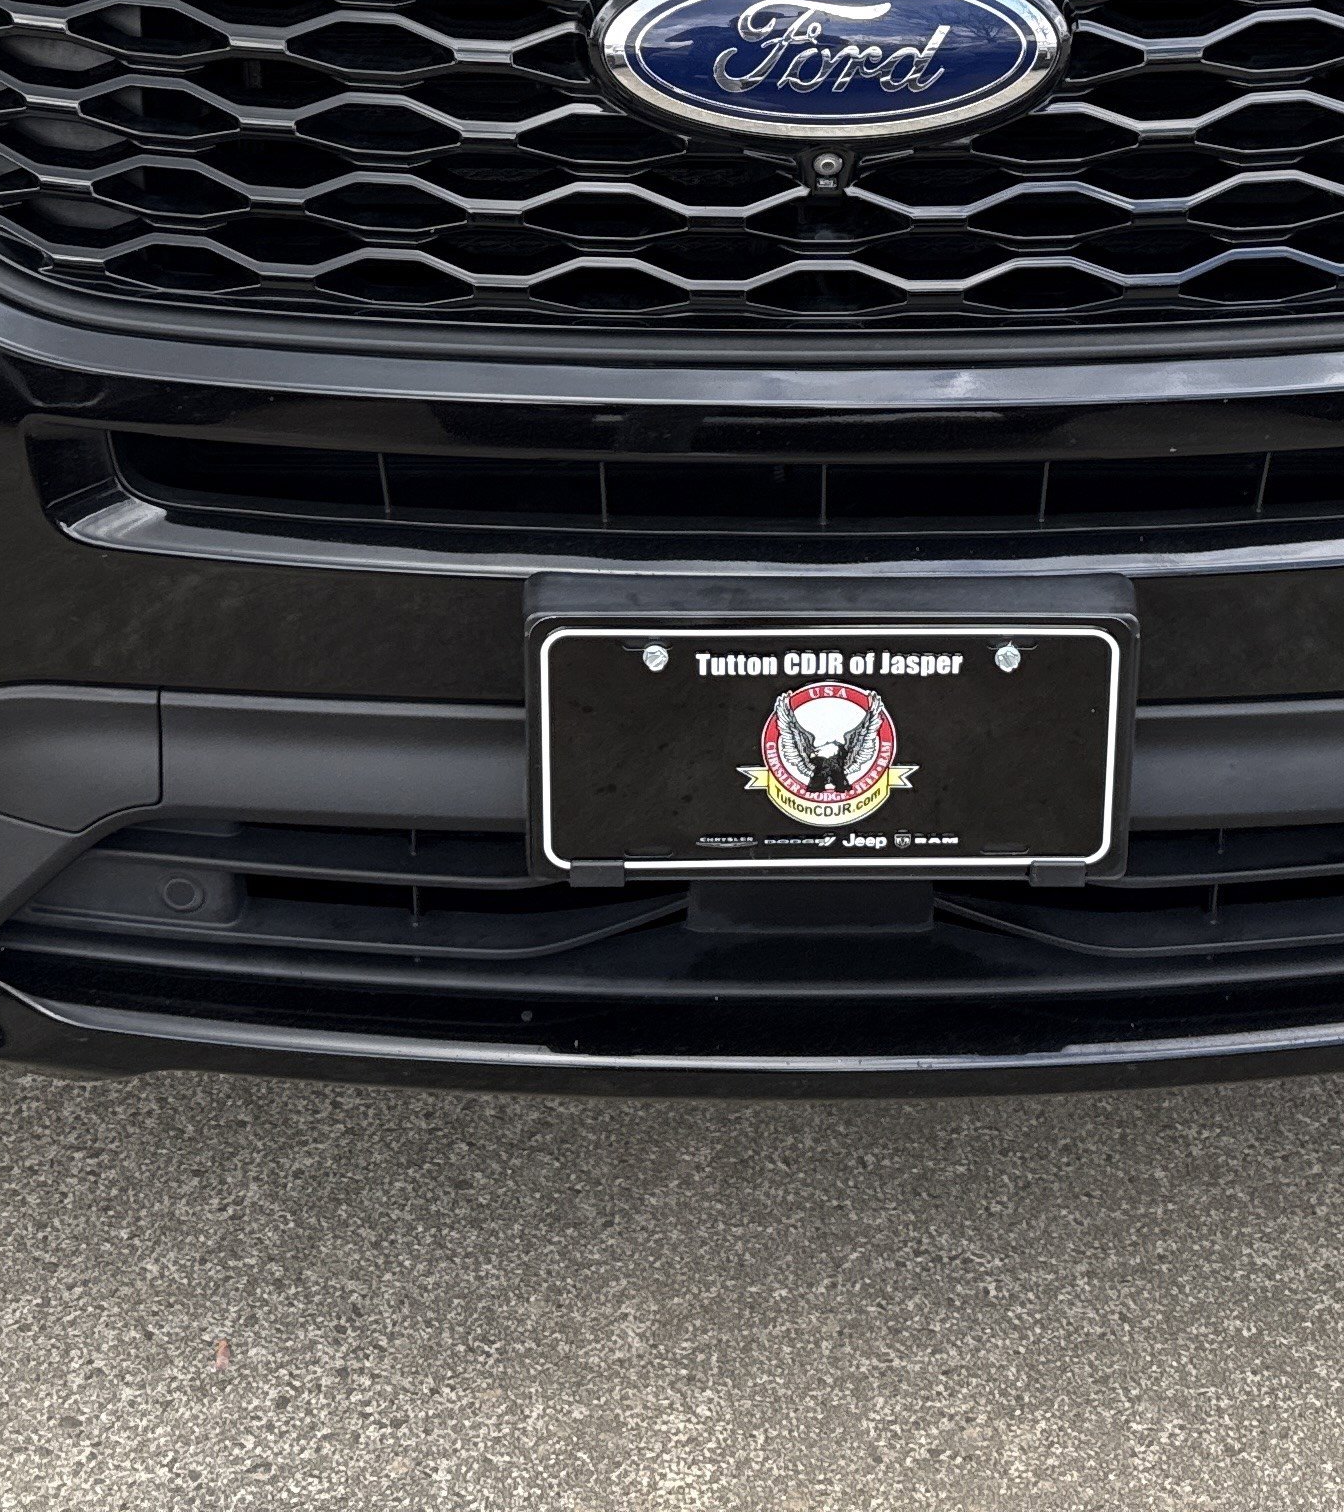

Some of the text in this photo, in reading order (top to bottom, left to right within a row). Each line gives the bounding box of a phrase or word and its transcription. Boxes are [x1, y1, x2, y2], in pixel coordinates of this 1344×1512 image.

[695, 652, 964, 677] Tutton CDJR of Jasper
[807, 686, 849, 699] USA
[774, 785, 882, 818] TuttonCDJR.com
[842, 833, 888, 849] Jeep
